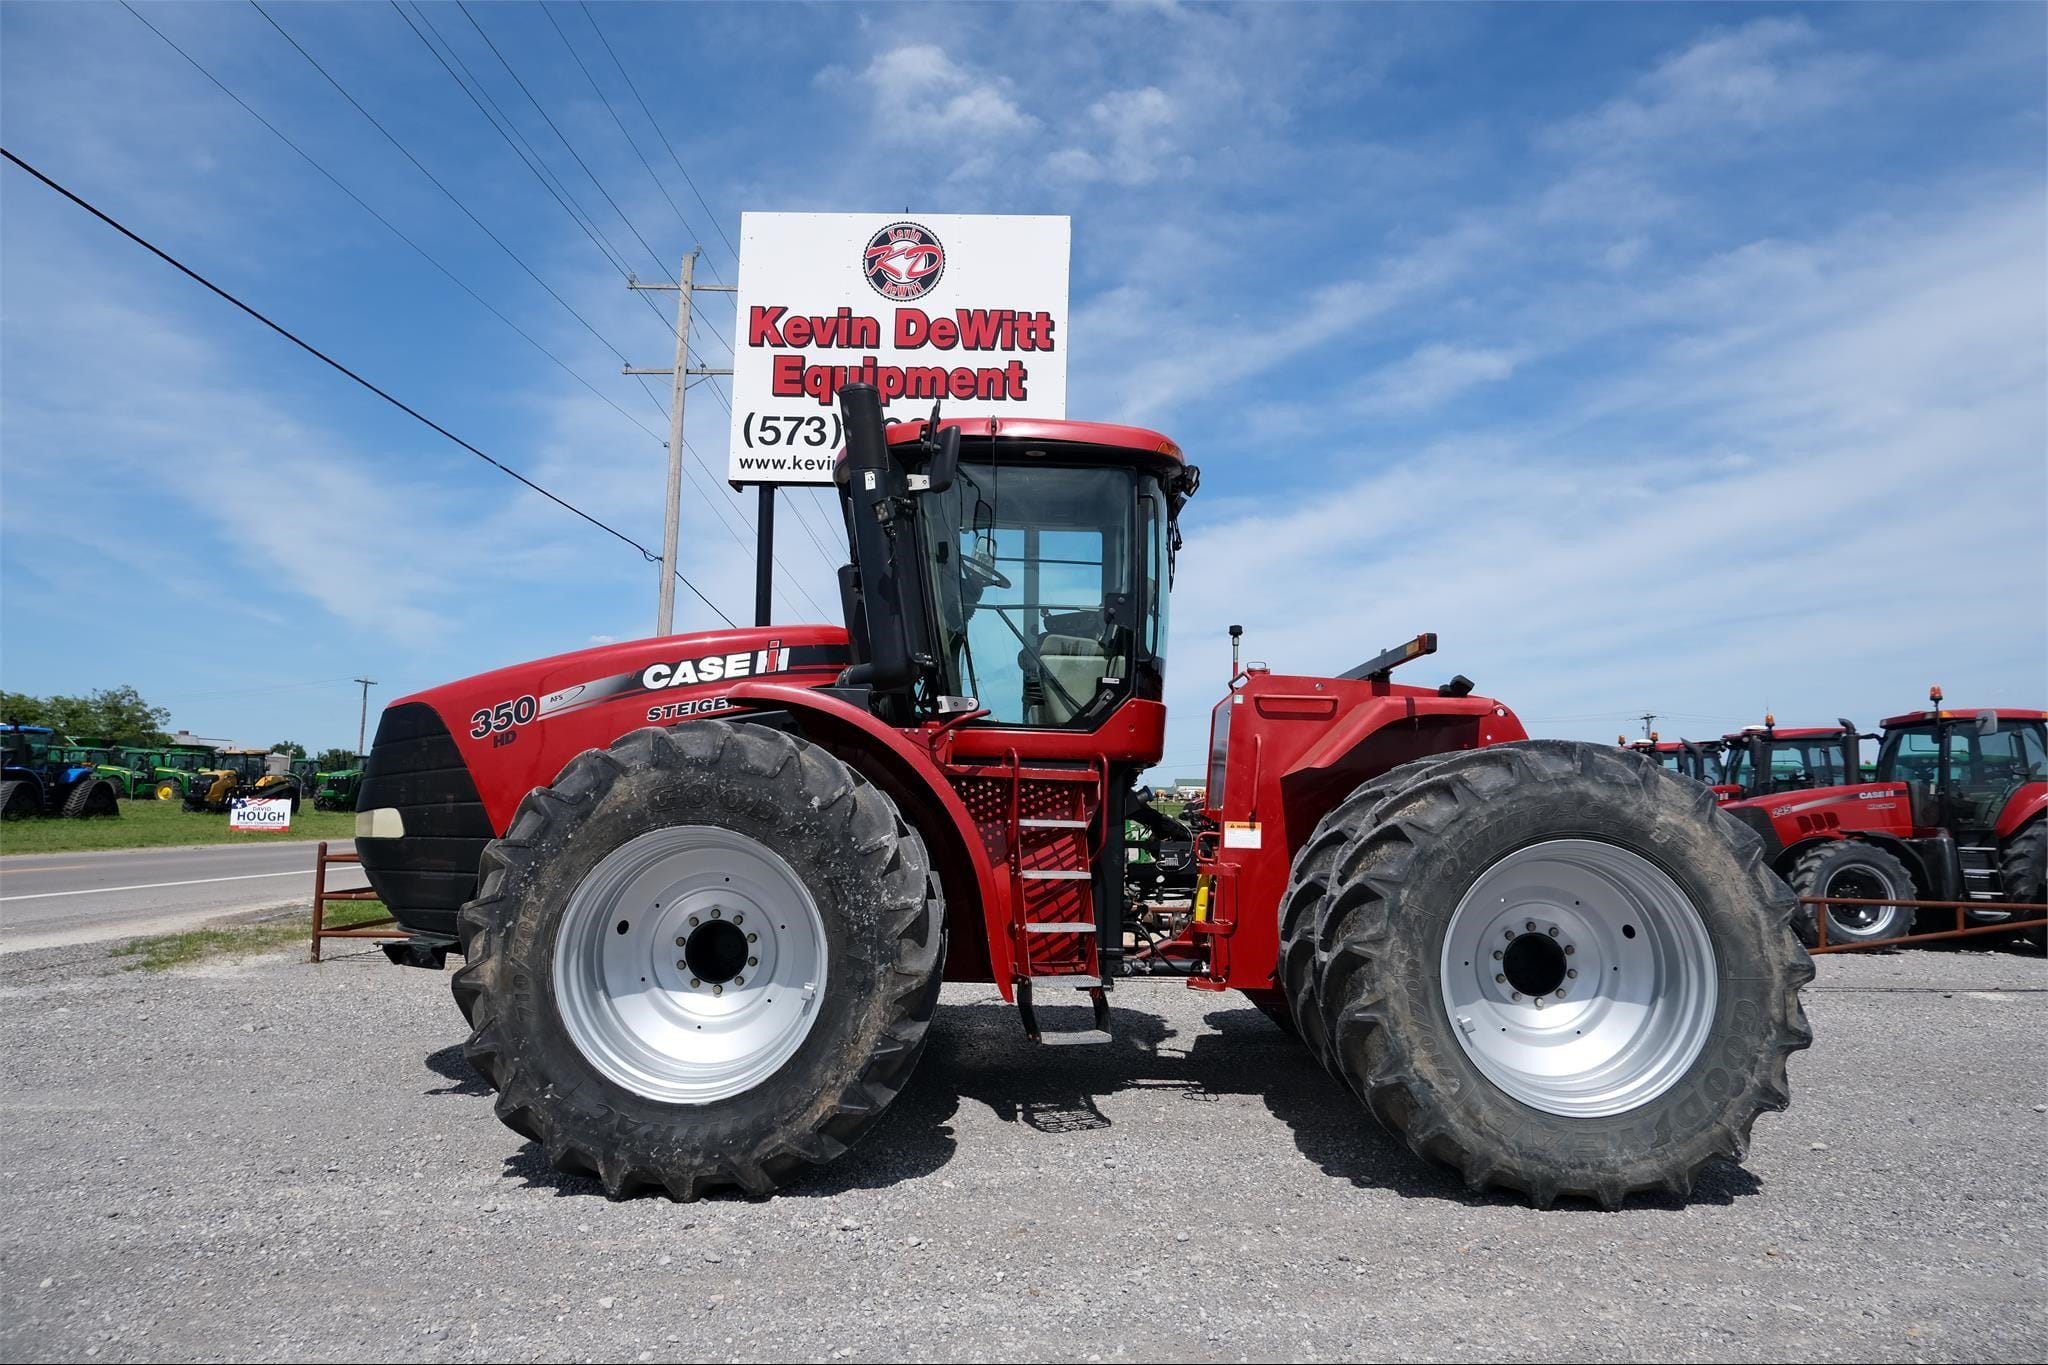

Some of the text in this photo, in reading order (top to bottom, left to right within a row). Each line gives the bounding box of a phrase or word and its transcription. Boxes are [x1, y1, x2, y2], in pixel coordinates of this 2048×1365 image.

[887, 228, 922, 241] Kevin
[866, 244, 943, 279] KD
[882, 281, 924, 297] DeWitt
[749, 306, 1055, 352] Kevin DeWitt
[772, 354, 1027, 407] Equipment
[743, 412, 842, 449] (573)
[642, 653, 751, 690] CASE
[470, 694, 563, 739] 350 AFS
[647, 696, 741, 722] STEIGE
[493, 730, 517, 748] HD
[1859, 790, 1885, 799] CASE
[237, 811, 285, 821] HOUGH
[1772, 805, 1792, 817] 245
